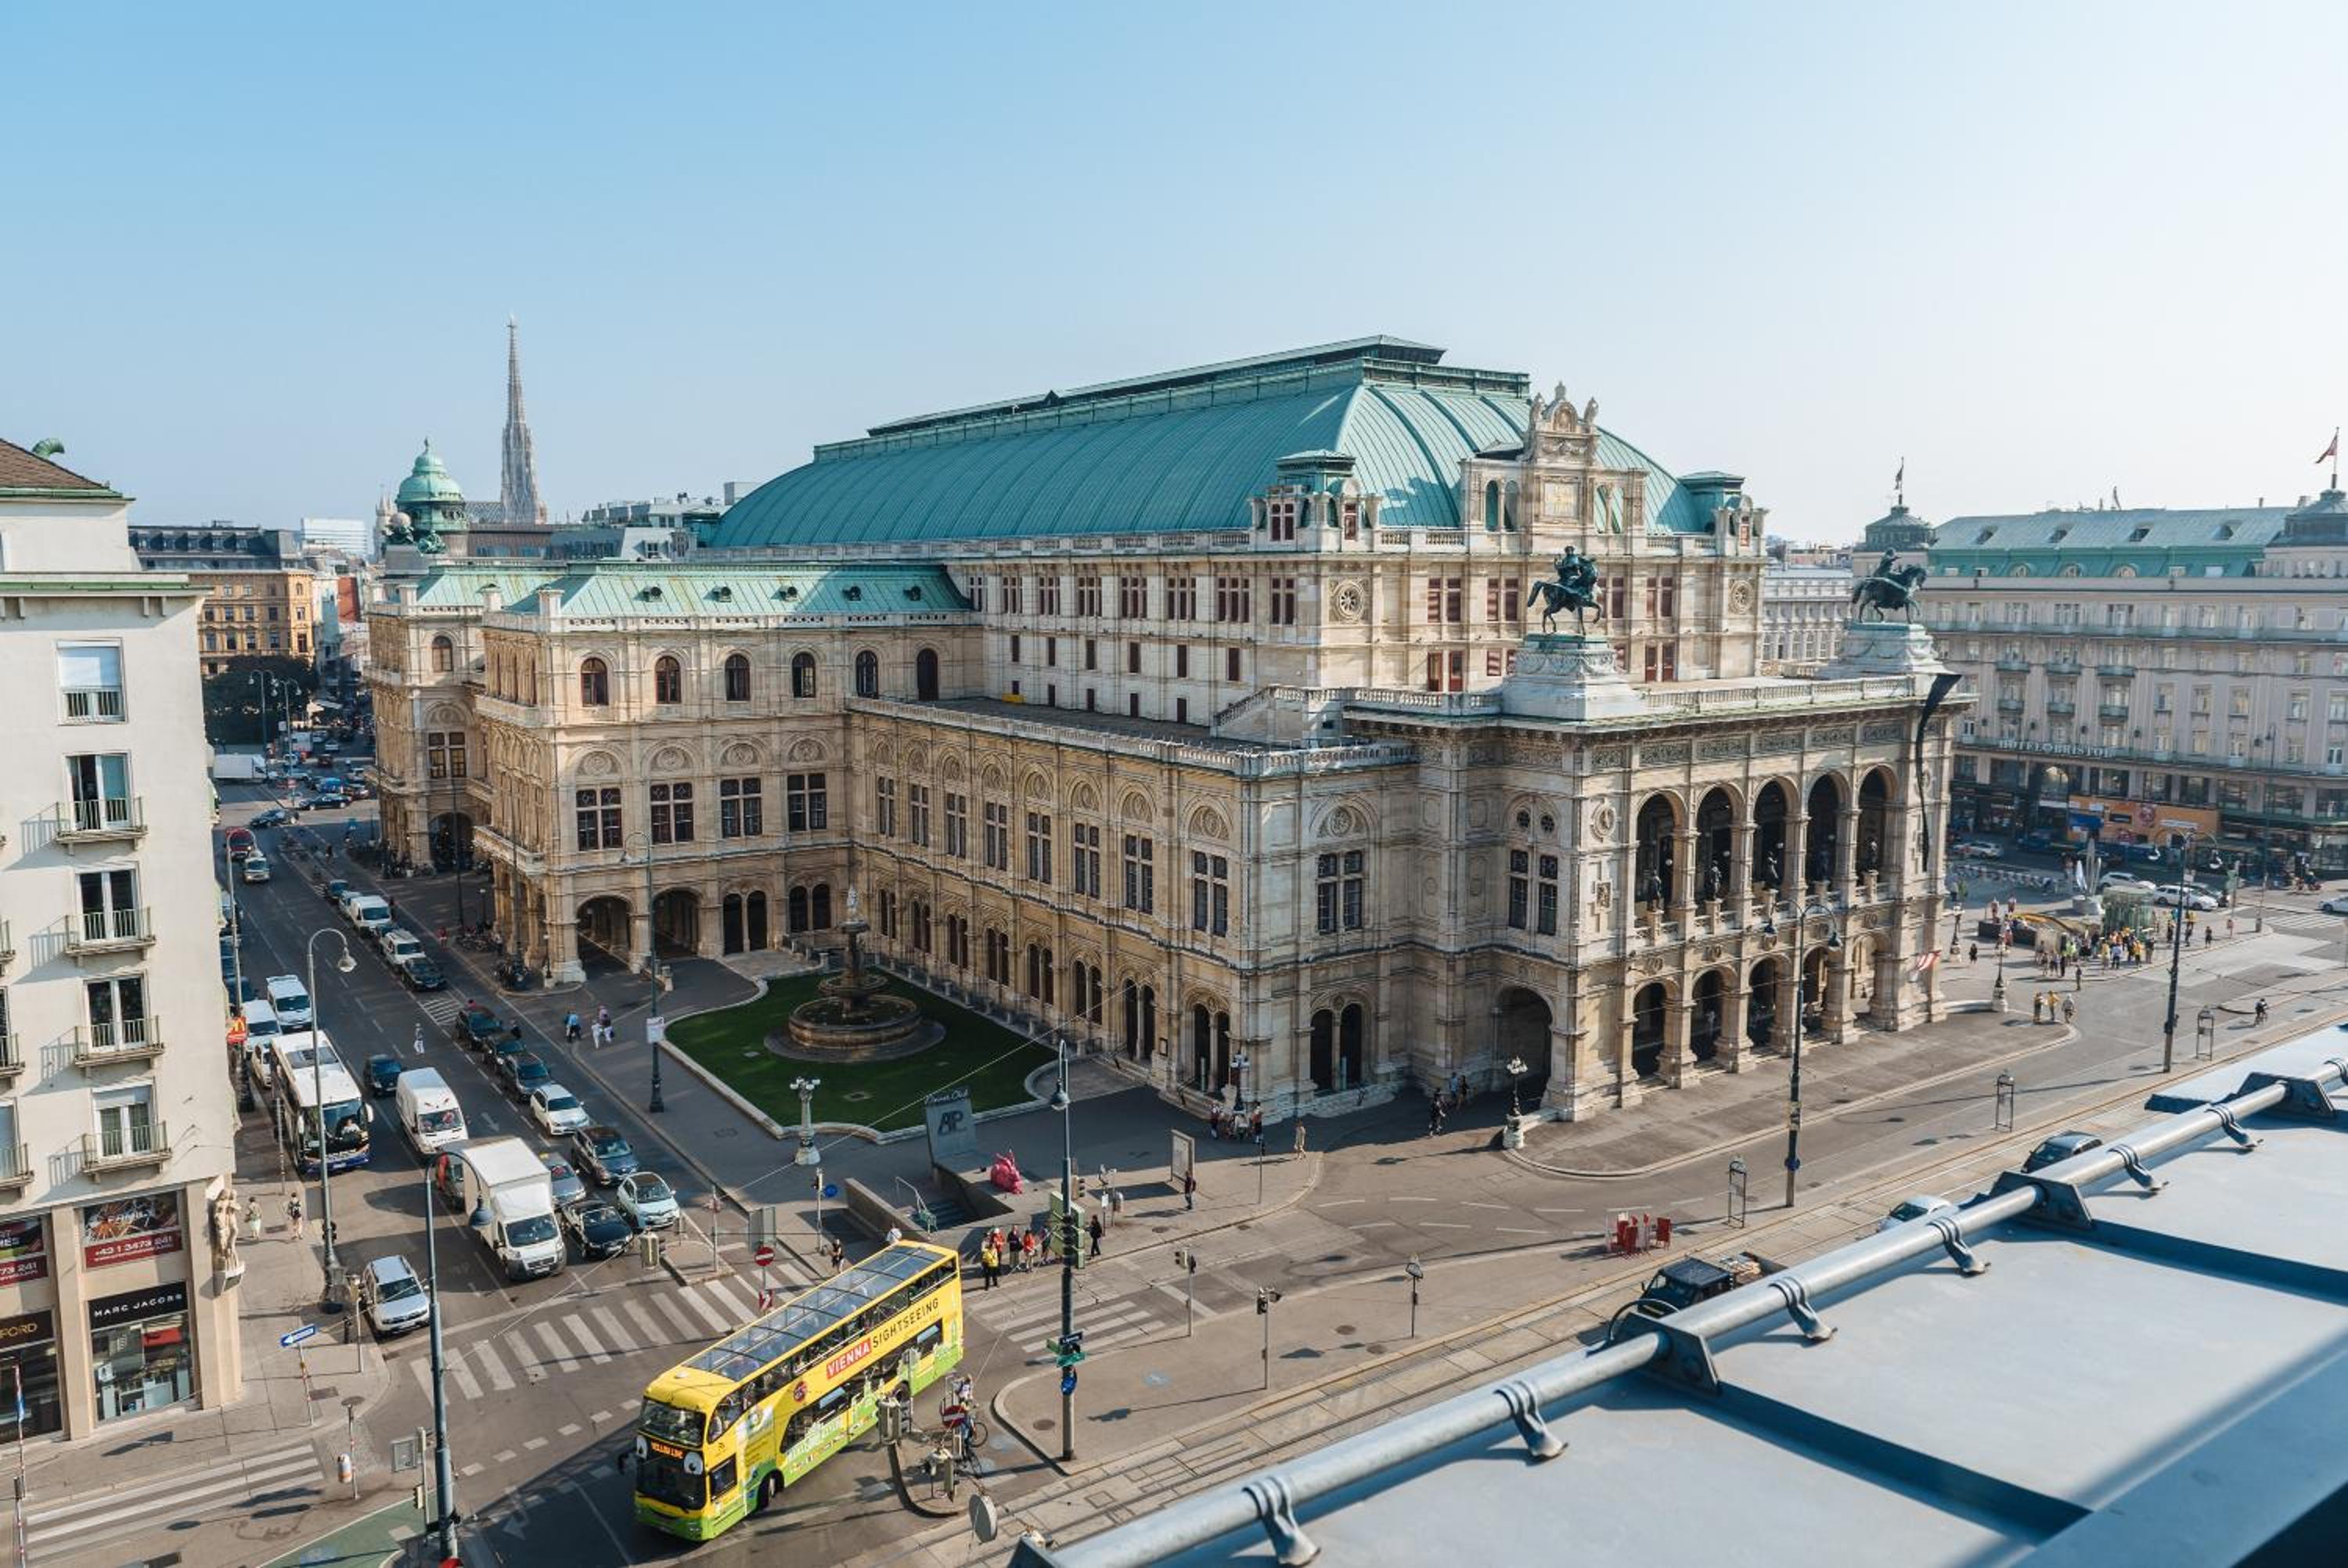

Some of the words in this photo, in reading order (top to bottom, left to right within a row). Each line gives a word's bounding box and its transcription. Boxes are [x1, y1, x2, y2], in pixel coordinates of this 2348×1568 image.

[17, 1261, 38, 1272] 241
[94, 1304, 128, 1318] MARC
[132, 1293, 183, 1310] JACOBS
[0, 1322, 38, 1339] FORD
[827, 1343, 871, 1376] VIENNA
[873, 1297, 939, 1349] SIGHTSEEING
